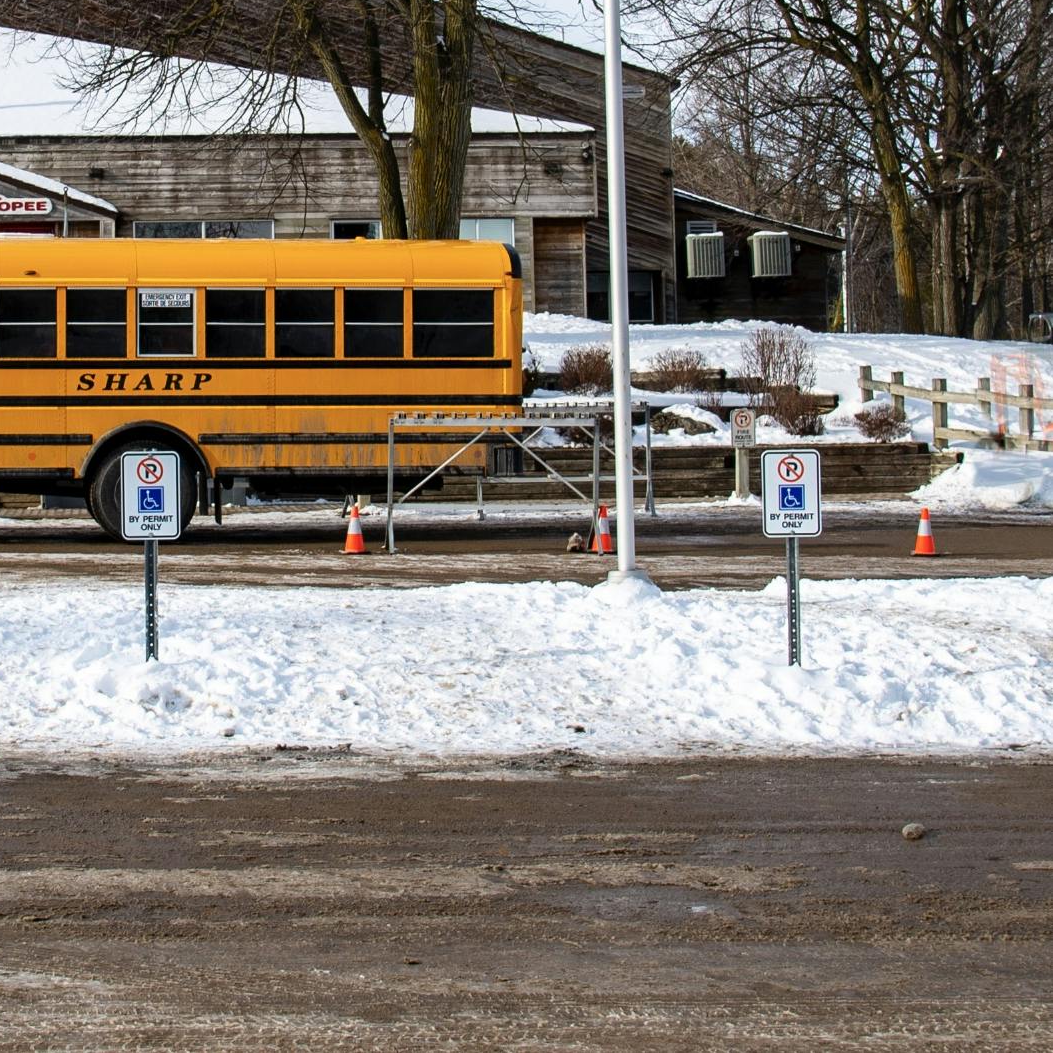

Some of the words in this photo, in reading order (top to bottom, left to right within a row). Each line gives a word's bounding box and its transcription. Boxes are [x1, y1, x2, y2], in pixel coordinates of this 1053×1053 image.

[77, 373, 212, 391] SHARP
[129, 515, 140, 523] BY
[143, 515, 174, 523] PERMIT
[770, 513, 781, 521] BY
[784, 513, 815, 521] PERMIT
[140, 523, 162, 531] ONLY
[782, 521, 803, 529] ONLY
